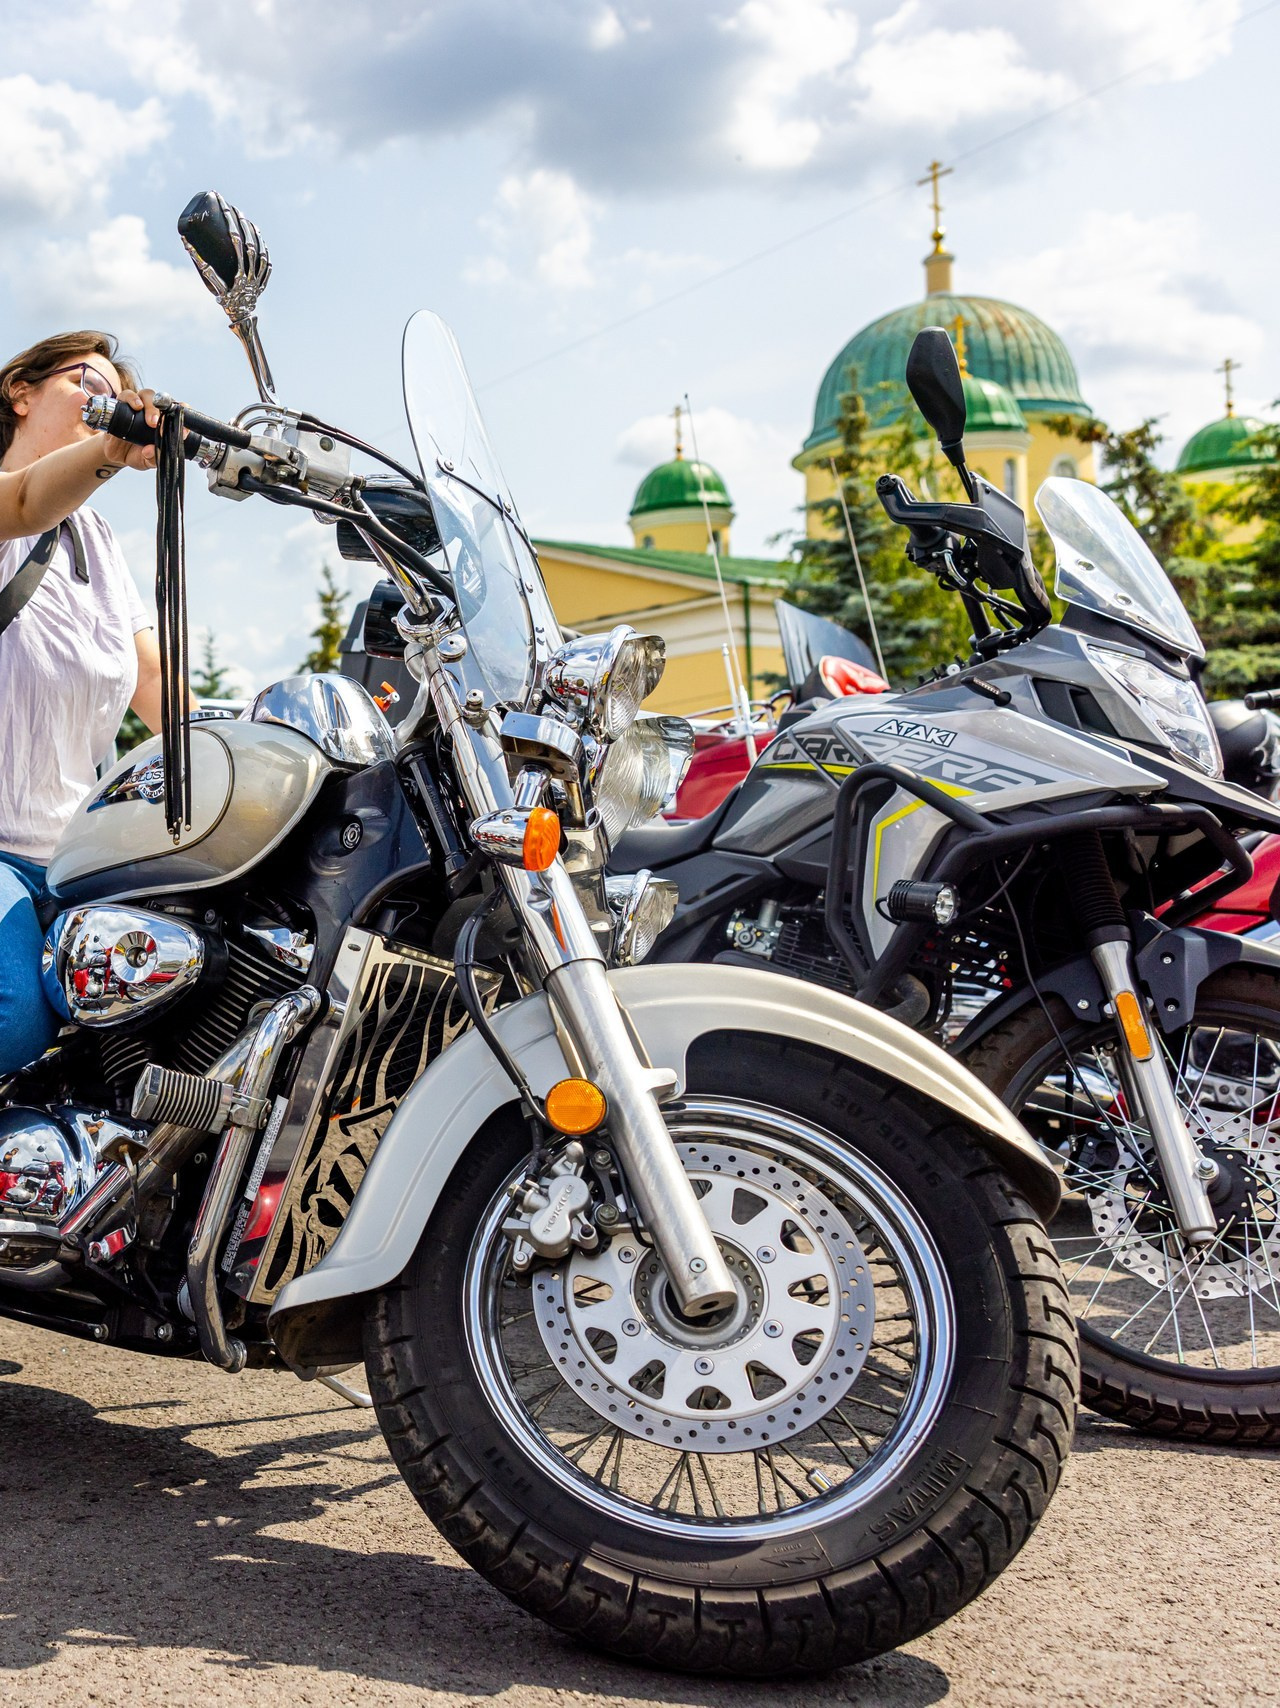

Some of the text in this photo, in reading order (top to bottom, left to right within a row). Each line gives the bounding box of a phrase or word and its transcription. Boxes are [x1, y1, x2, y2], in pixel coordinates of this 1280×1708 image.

[873, 719, 958, 749] ATAKI
[142, 784, 165, 799] SUZUK
[543, 1184, 575, 1236] TOKICO
[869, 1449, 967, 1542] MITAS
